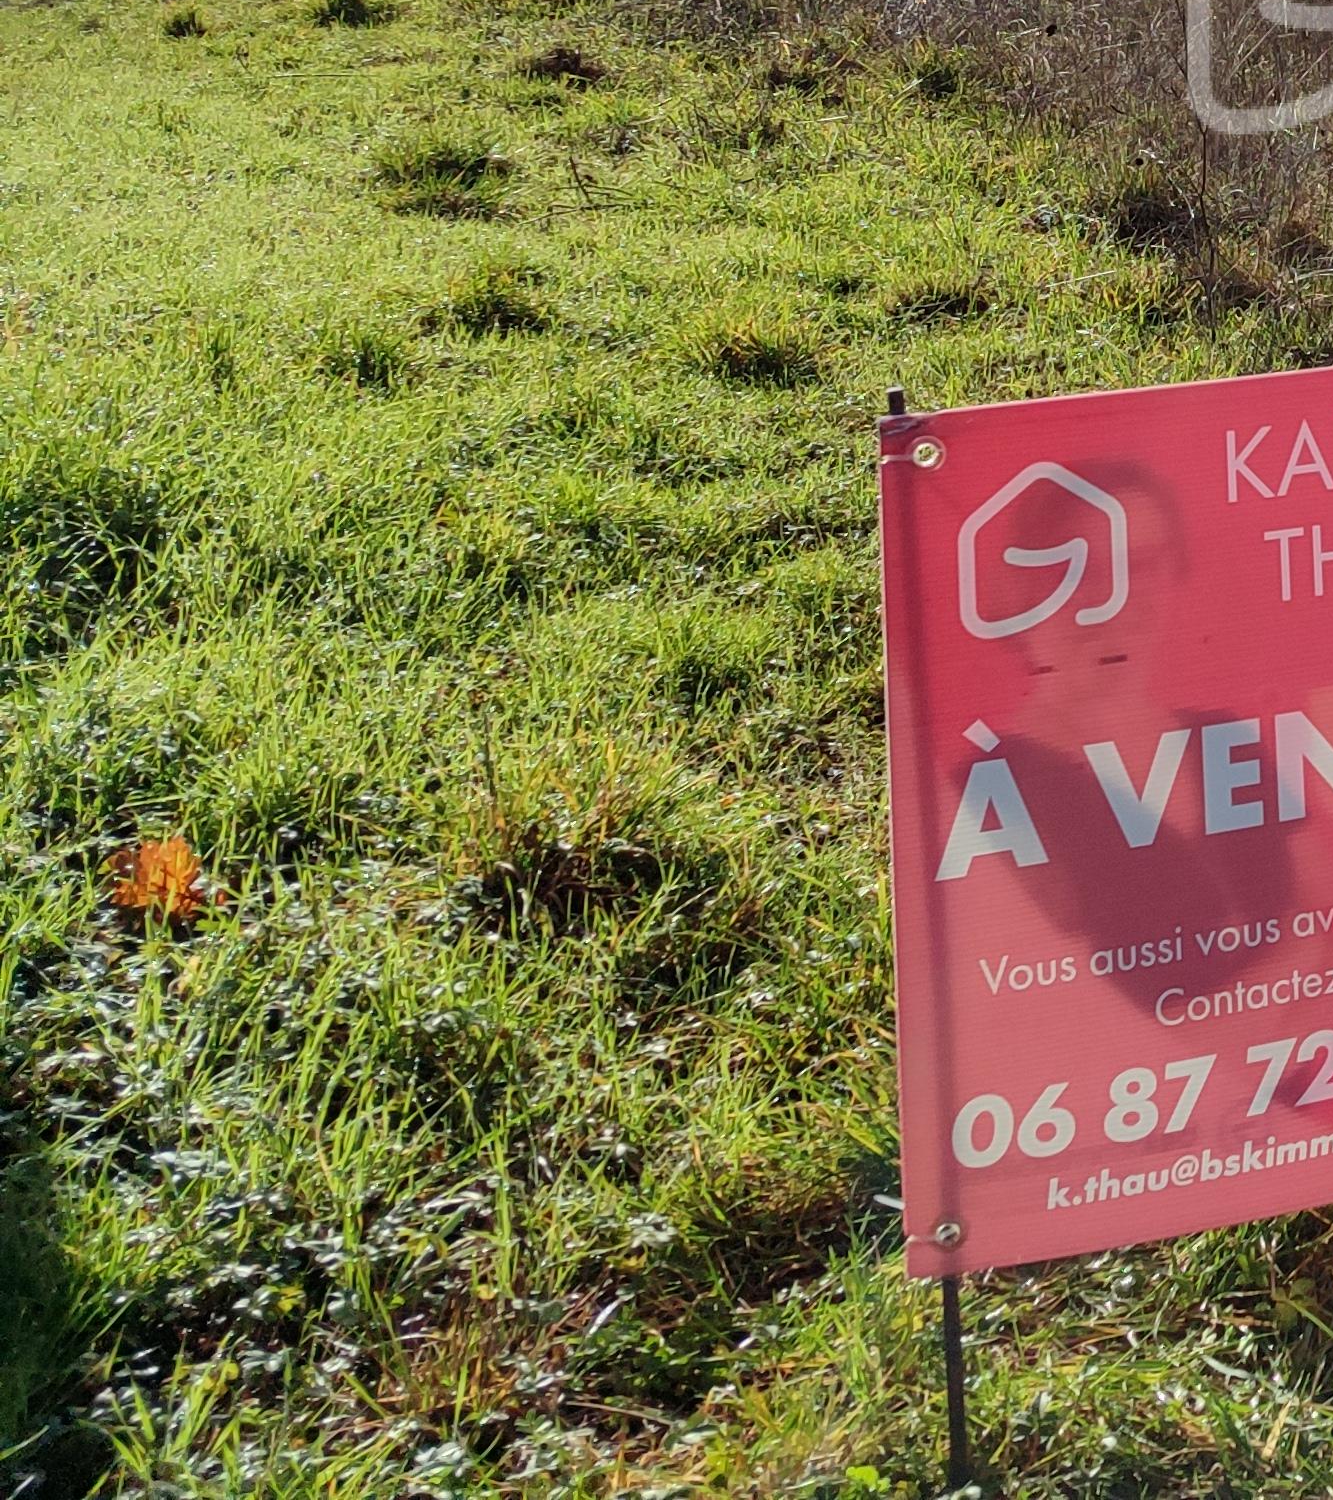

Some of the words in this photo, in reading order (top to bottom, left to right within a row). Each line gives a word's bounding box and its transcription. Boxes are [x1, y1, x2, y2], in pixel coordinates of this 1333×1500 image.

[934, 718, 1049, 882] À
[979, 954, 1077, 995] Vous
[1089, 927, 1183, 977] aussi
[1195, 912, 1281, 956] vous
[951, 1082, 1077, 1169] 06
[1103, 1054, 1217, 1143] 87
